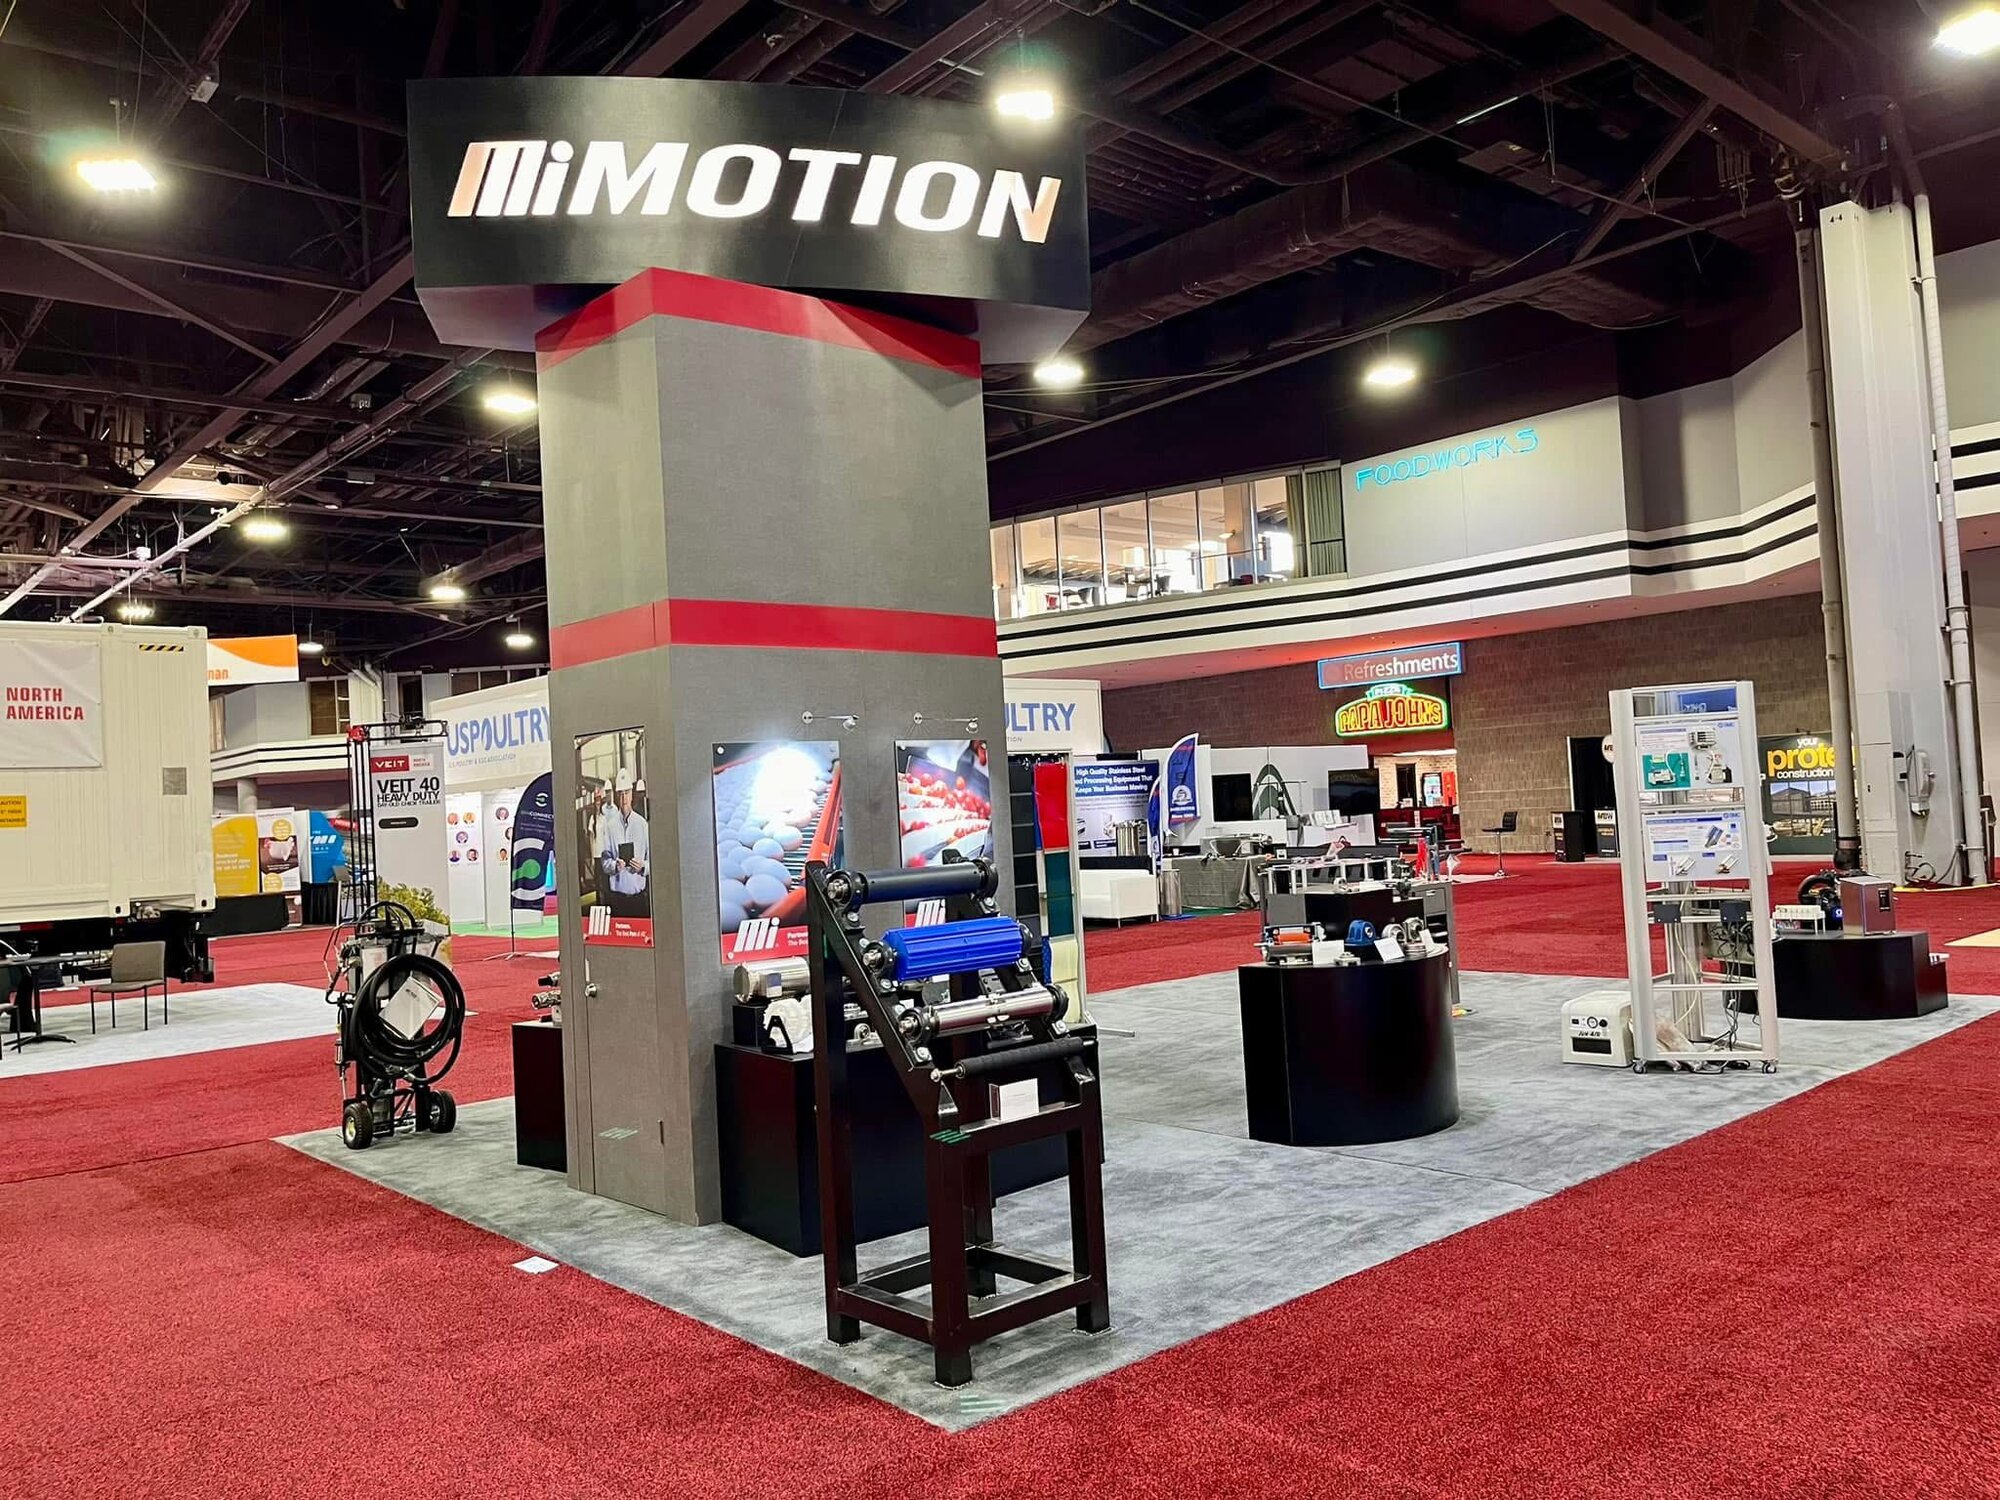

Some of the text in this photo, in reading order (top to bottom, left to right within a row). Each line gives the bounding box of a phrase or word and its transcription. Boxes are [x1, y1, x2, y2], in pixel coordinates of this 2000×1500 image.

[1355, 427, 1540, 492] FOODWORKS
[1343, 652, 1459, 681] Refreshments
[6, 687, 63, 702] NORTH
[6, 705, 85, 720] AMERICA
[1340, 700, 1384, 732] PAPA
[1796, 737, 1819, 749] your
[375, 759, 406, 769] VEIT
[1776, 769, 1834, 779] construction
[376, 776, 440, 794] VEIT 40
[377, 790, 440, 804] HEAVY DUTY
